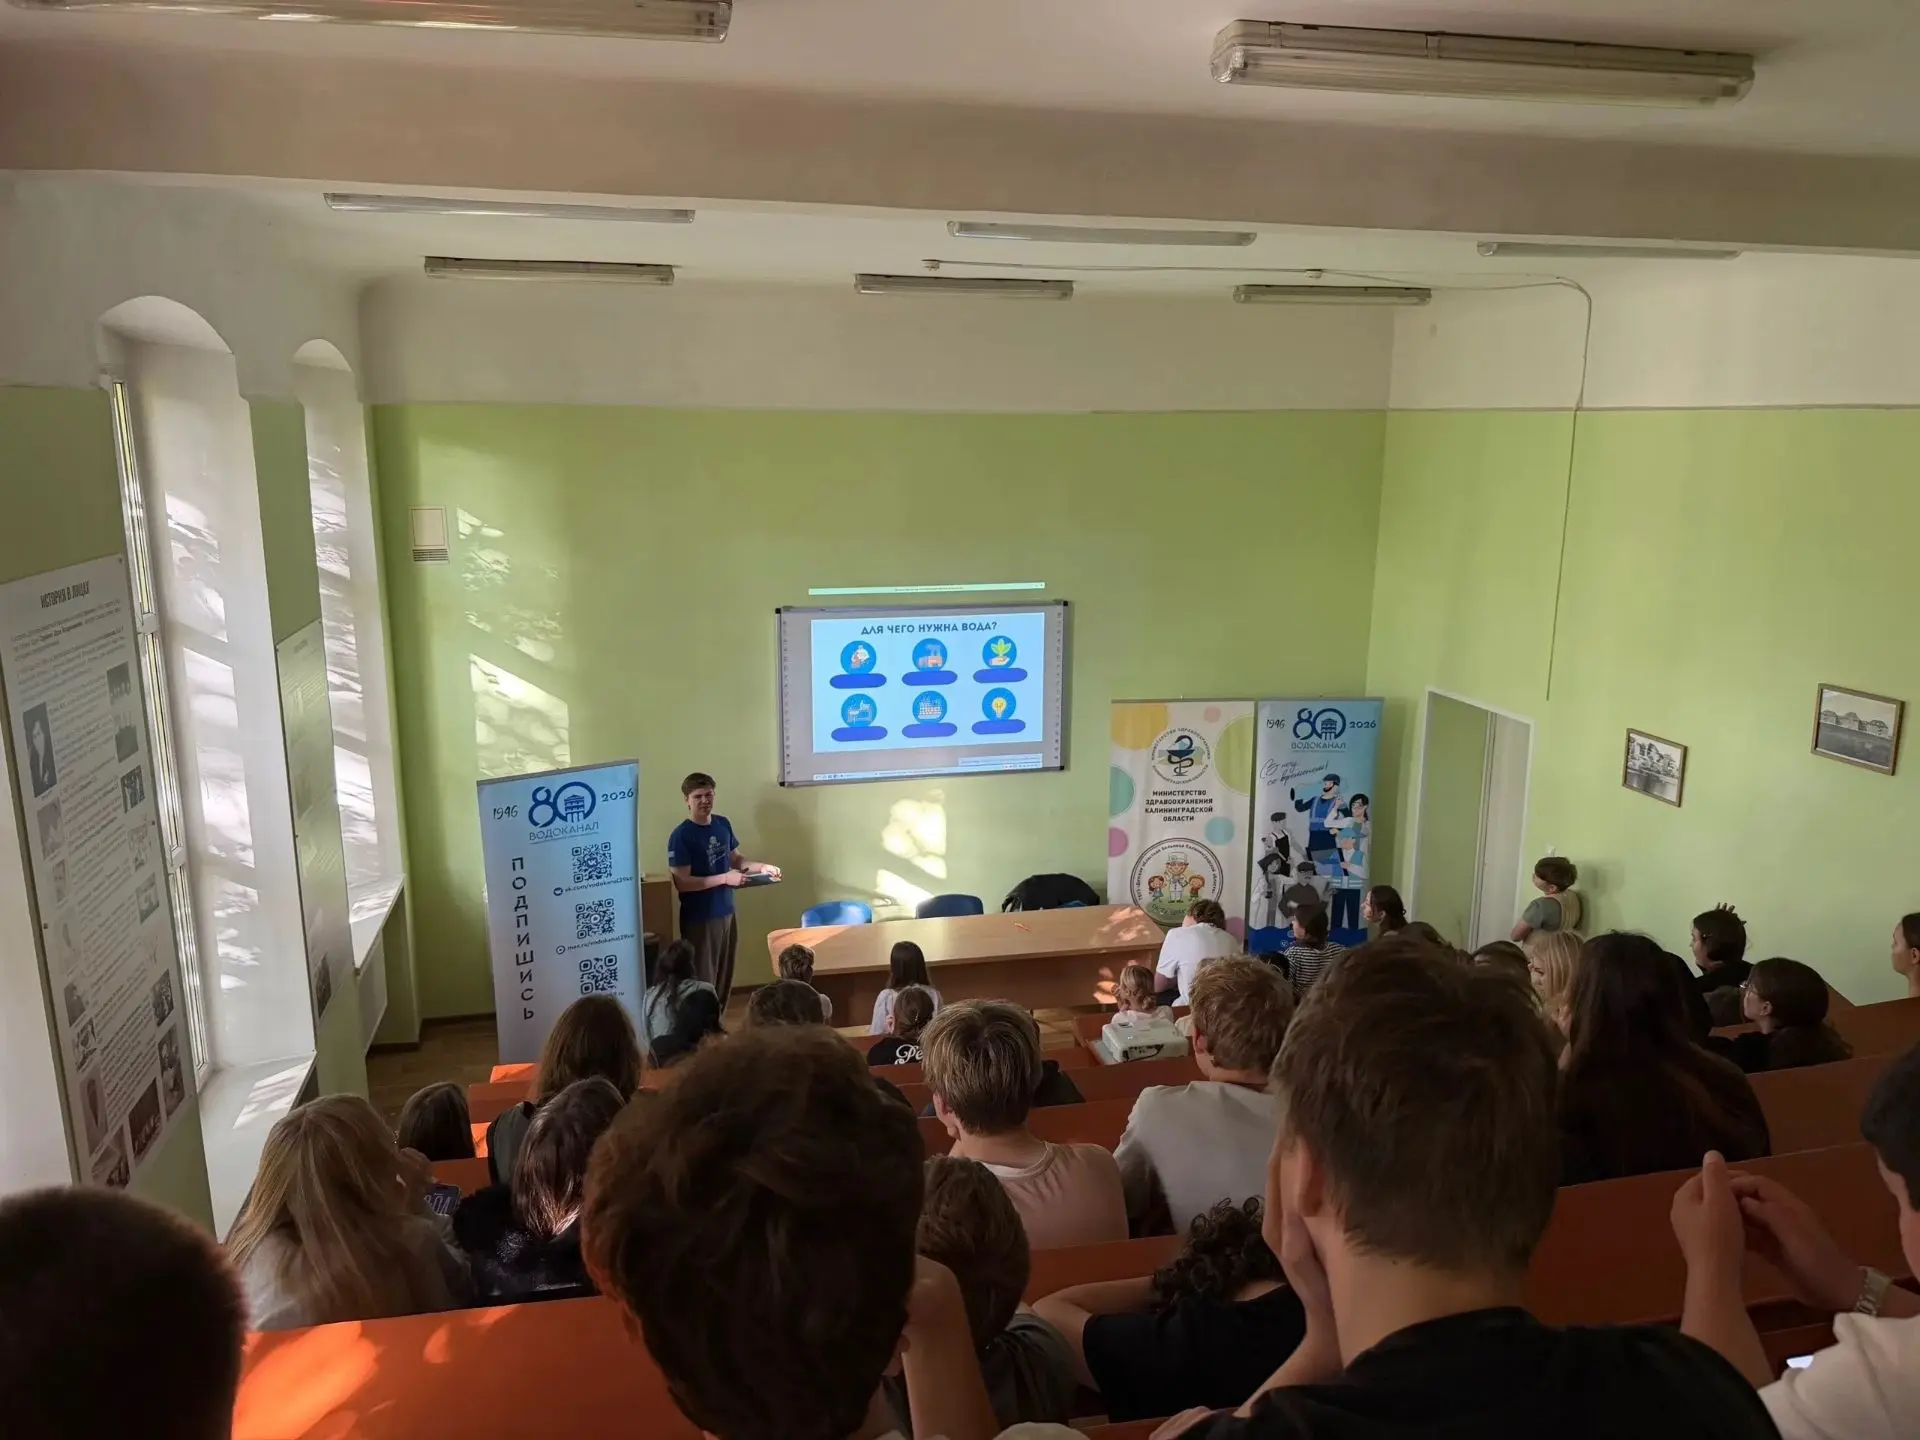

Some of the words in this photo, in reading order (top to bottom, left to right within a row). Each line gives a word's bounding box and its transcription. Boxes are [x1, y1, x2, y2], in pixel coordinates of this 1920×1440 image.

[40, 588, 66, 608] ИСТОРИЯ
[66, 586, 72, 601] В
[72, 580, 90, 598] ЛИЦАХ
[861, 625, 884, 635] ДЛЯ
[887, 624, 915, 634] ЧЕГО
[918, 622, 959, 633] НУЖНА
[961, 621, 998, 632] ВОДА?
[1266, 719, 1286, 729] 1946
[1292, 708, 1347, 741] 80
[1349, 720, 1377, 729] 2026
[1291, 742, 1346, 750] ВОДОКАНАЛ
[601, 788, 634, 802] 2026
[1145, 798, 1214, 806] ЗДРАВООХРАНЕНИЯ
[528, 781, 596, 829] 80
[1145, 806, 1214, 814] КАЛИНИНГРАДСКОЙ
[493, 805, 519, 820] 1946
[529, 821, 600, 841] ВОДОКАНАЛ
[511, 857, 535, 1020] ПОДПИШИСЬ
